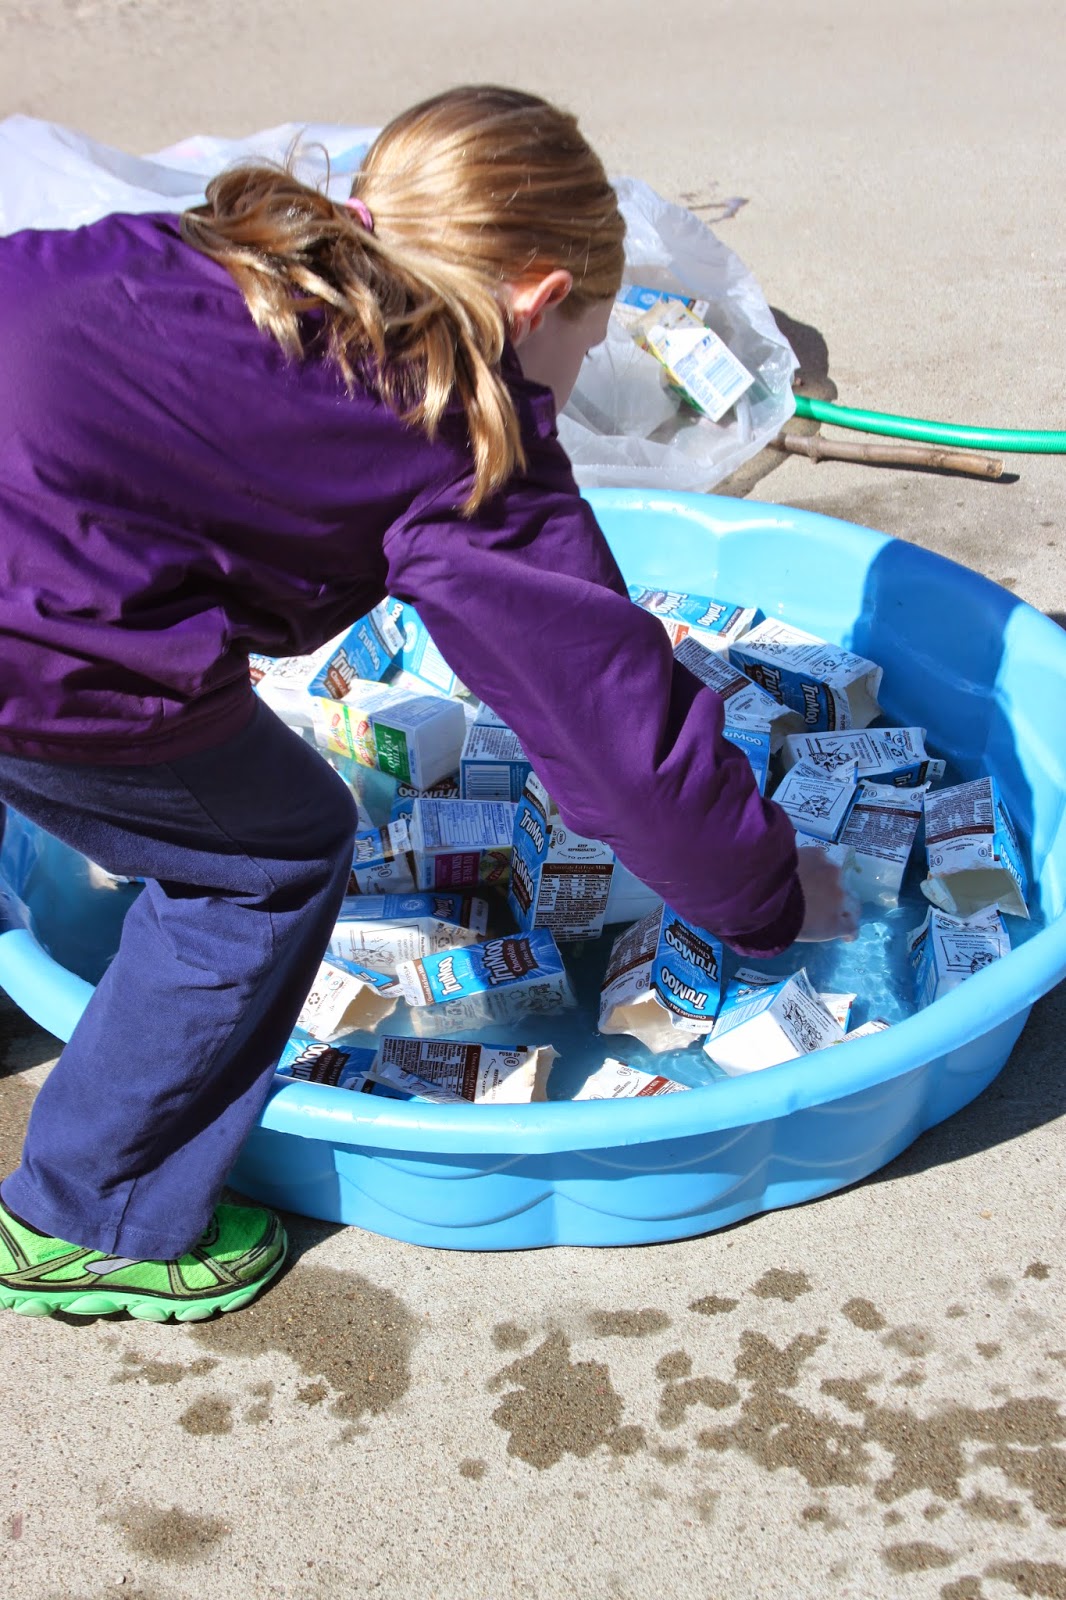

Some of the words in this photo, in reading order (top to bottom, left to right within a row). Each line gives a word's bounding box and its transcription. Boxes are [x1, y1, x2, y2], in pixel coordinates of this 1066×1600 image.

[697, 602, 727, 627] TruMoo
[330, 648, 361, 686] TruM
[357, 625, 381, 672] TruMoo
[801, 684, 820, 725] TruMoo
[724, 731, 763, 746] uMoo
[520, 809, 545, 854] TruMoo
[512, 846, 534, 901] TruMoo
[485, 939, 516, 985] TruMoo
[509, 944, 523, 973] Chocolate
[665, 930, 718, 982] TruMoo
[674, 931, 711, 960] Chocolate
[437, 955, 463, 996] TruMoo
[661, 967, 708, 1010] TruMoo
[291, 1043, 330, 1079] uMoo
